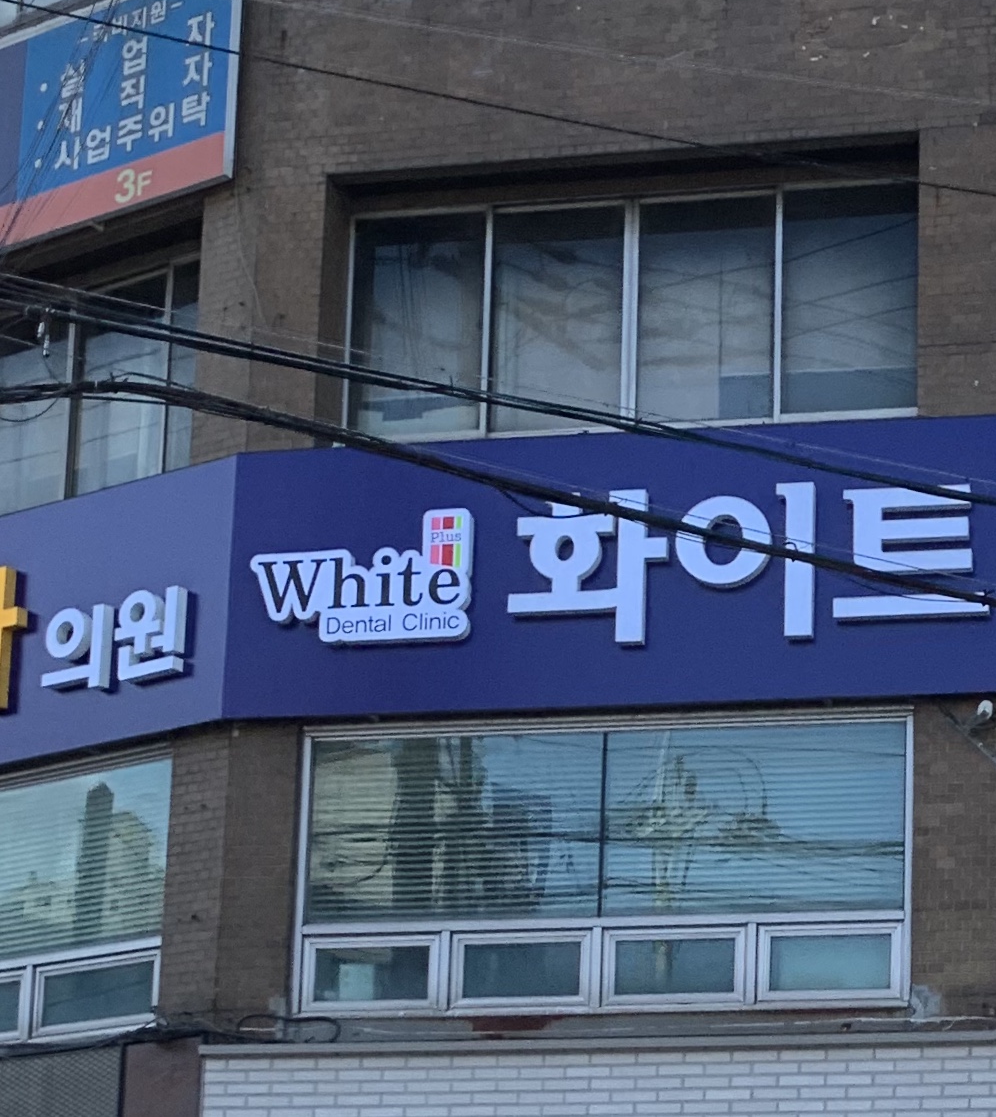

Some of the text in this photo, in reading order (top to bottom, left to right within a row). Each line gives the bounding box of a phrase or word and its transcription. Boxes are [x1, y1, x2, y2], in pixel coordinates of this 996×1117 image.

[114, 168, 153, 205] 3F
[430, 531, 462, 543] Plus
[507, 481, 991, 647] 화이트
[257, 554, 461, 614] White
[326, 611, 461, 634] Dental Clinic
